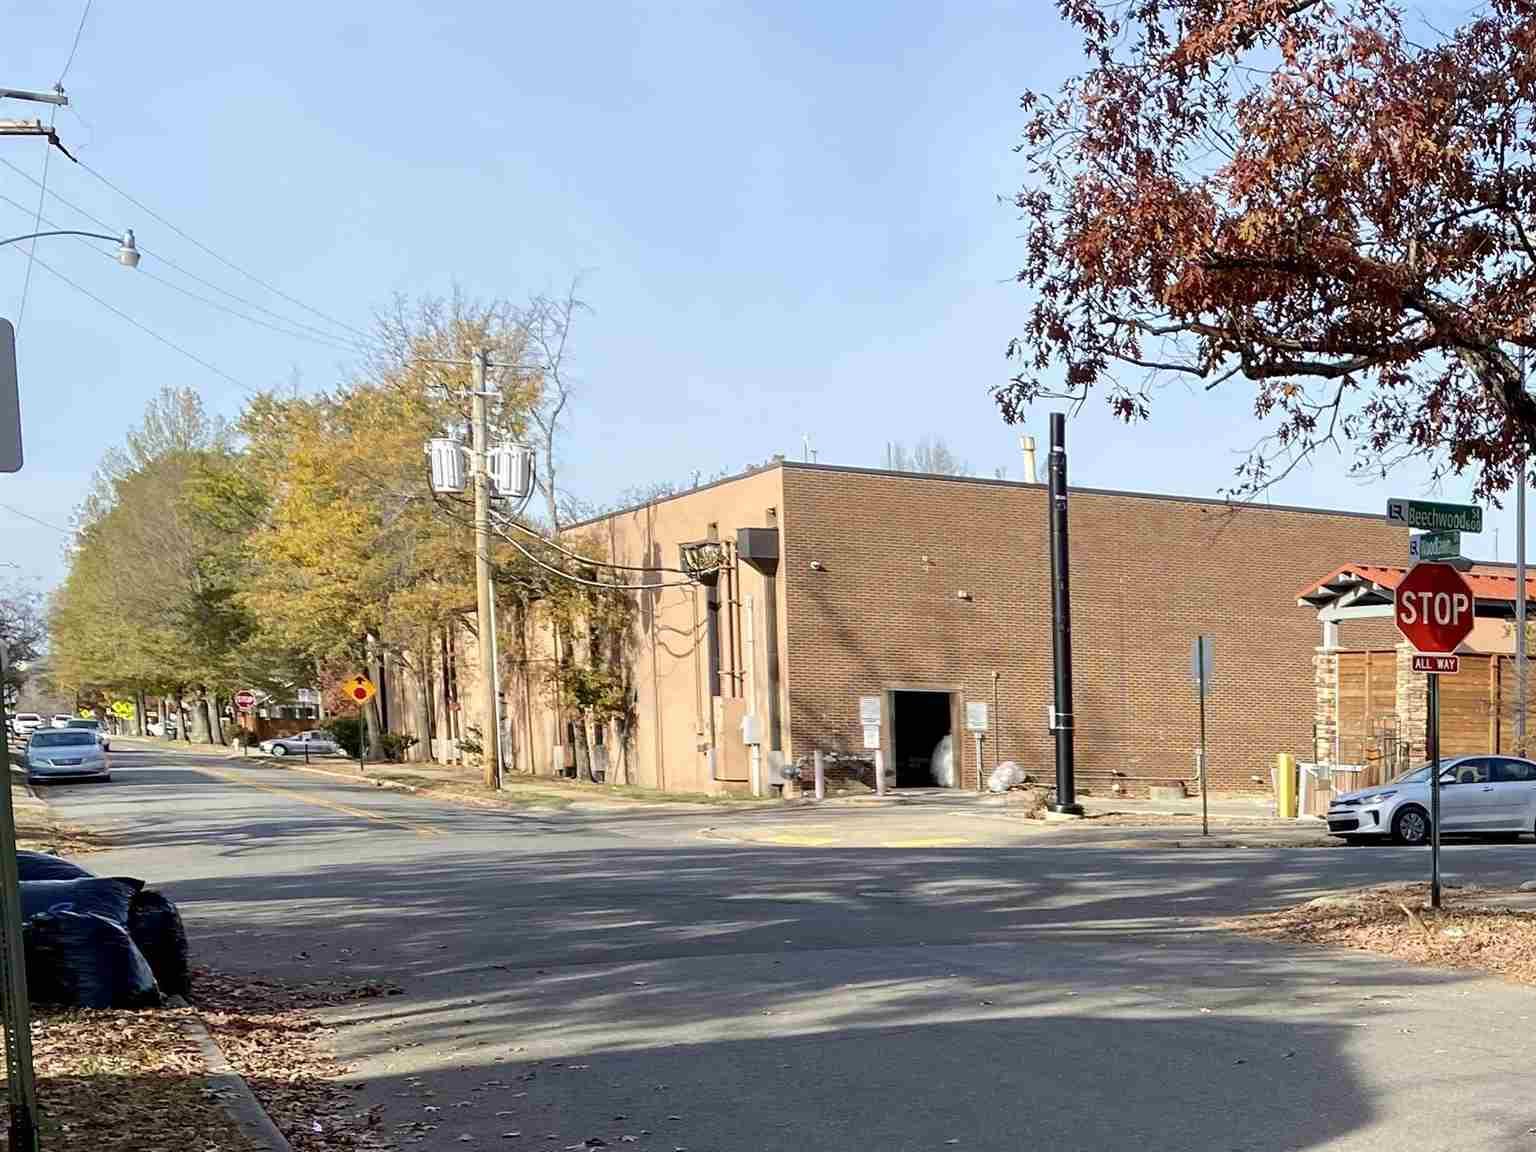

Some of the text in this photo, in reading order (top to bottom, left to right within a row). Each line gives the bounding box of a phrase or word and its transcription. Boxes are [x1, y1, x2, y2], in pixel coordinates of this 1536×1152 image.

[1409, 507, 1466, 529] Beechwood
[1400, 590, 1469, 625] STOP
[1415, 658, 1456, 670] ALL WAY
